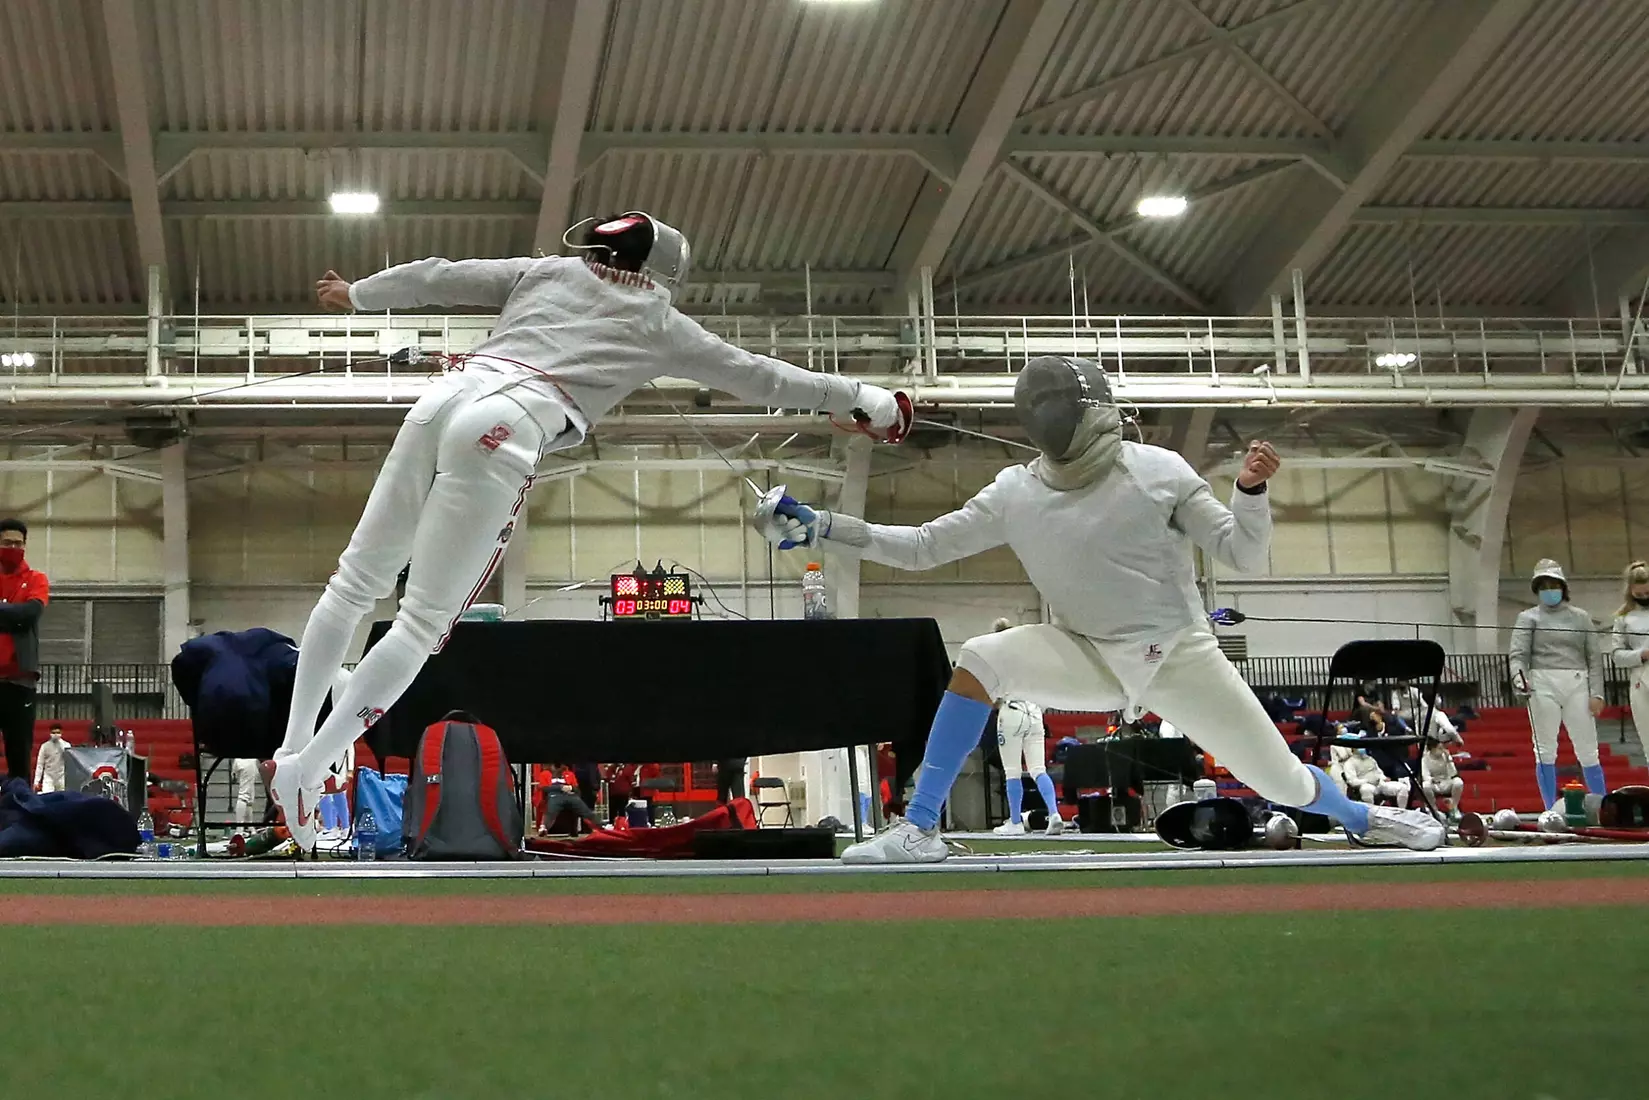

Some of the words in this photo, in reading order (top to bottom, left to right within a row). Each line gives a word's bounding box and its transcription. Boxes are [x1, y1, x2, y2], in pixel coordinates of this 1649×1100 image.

[616, 600, 635, 614] 03
[637, 600, 668, 610] 03:00
[669, 600, 690, 614] 04
